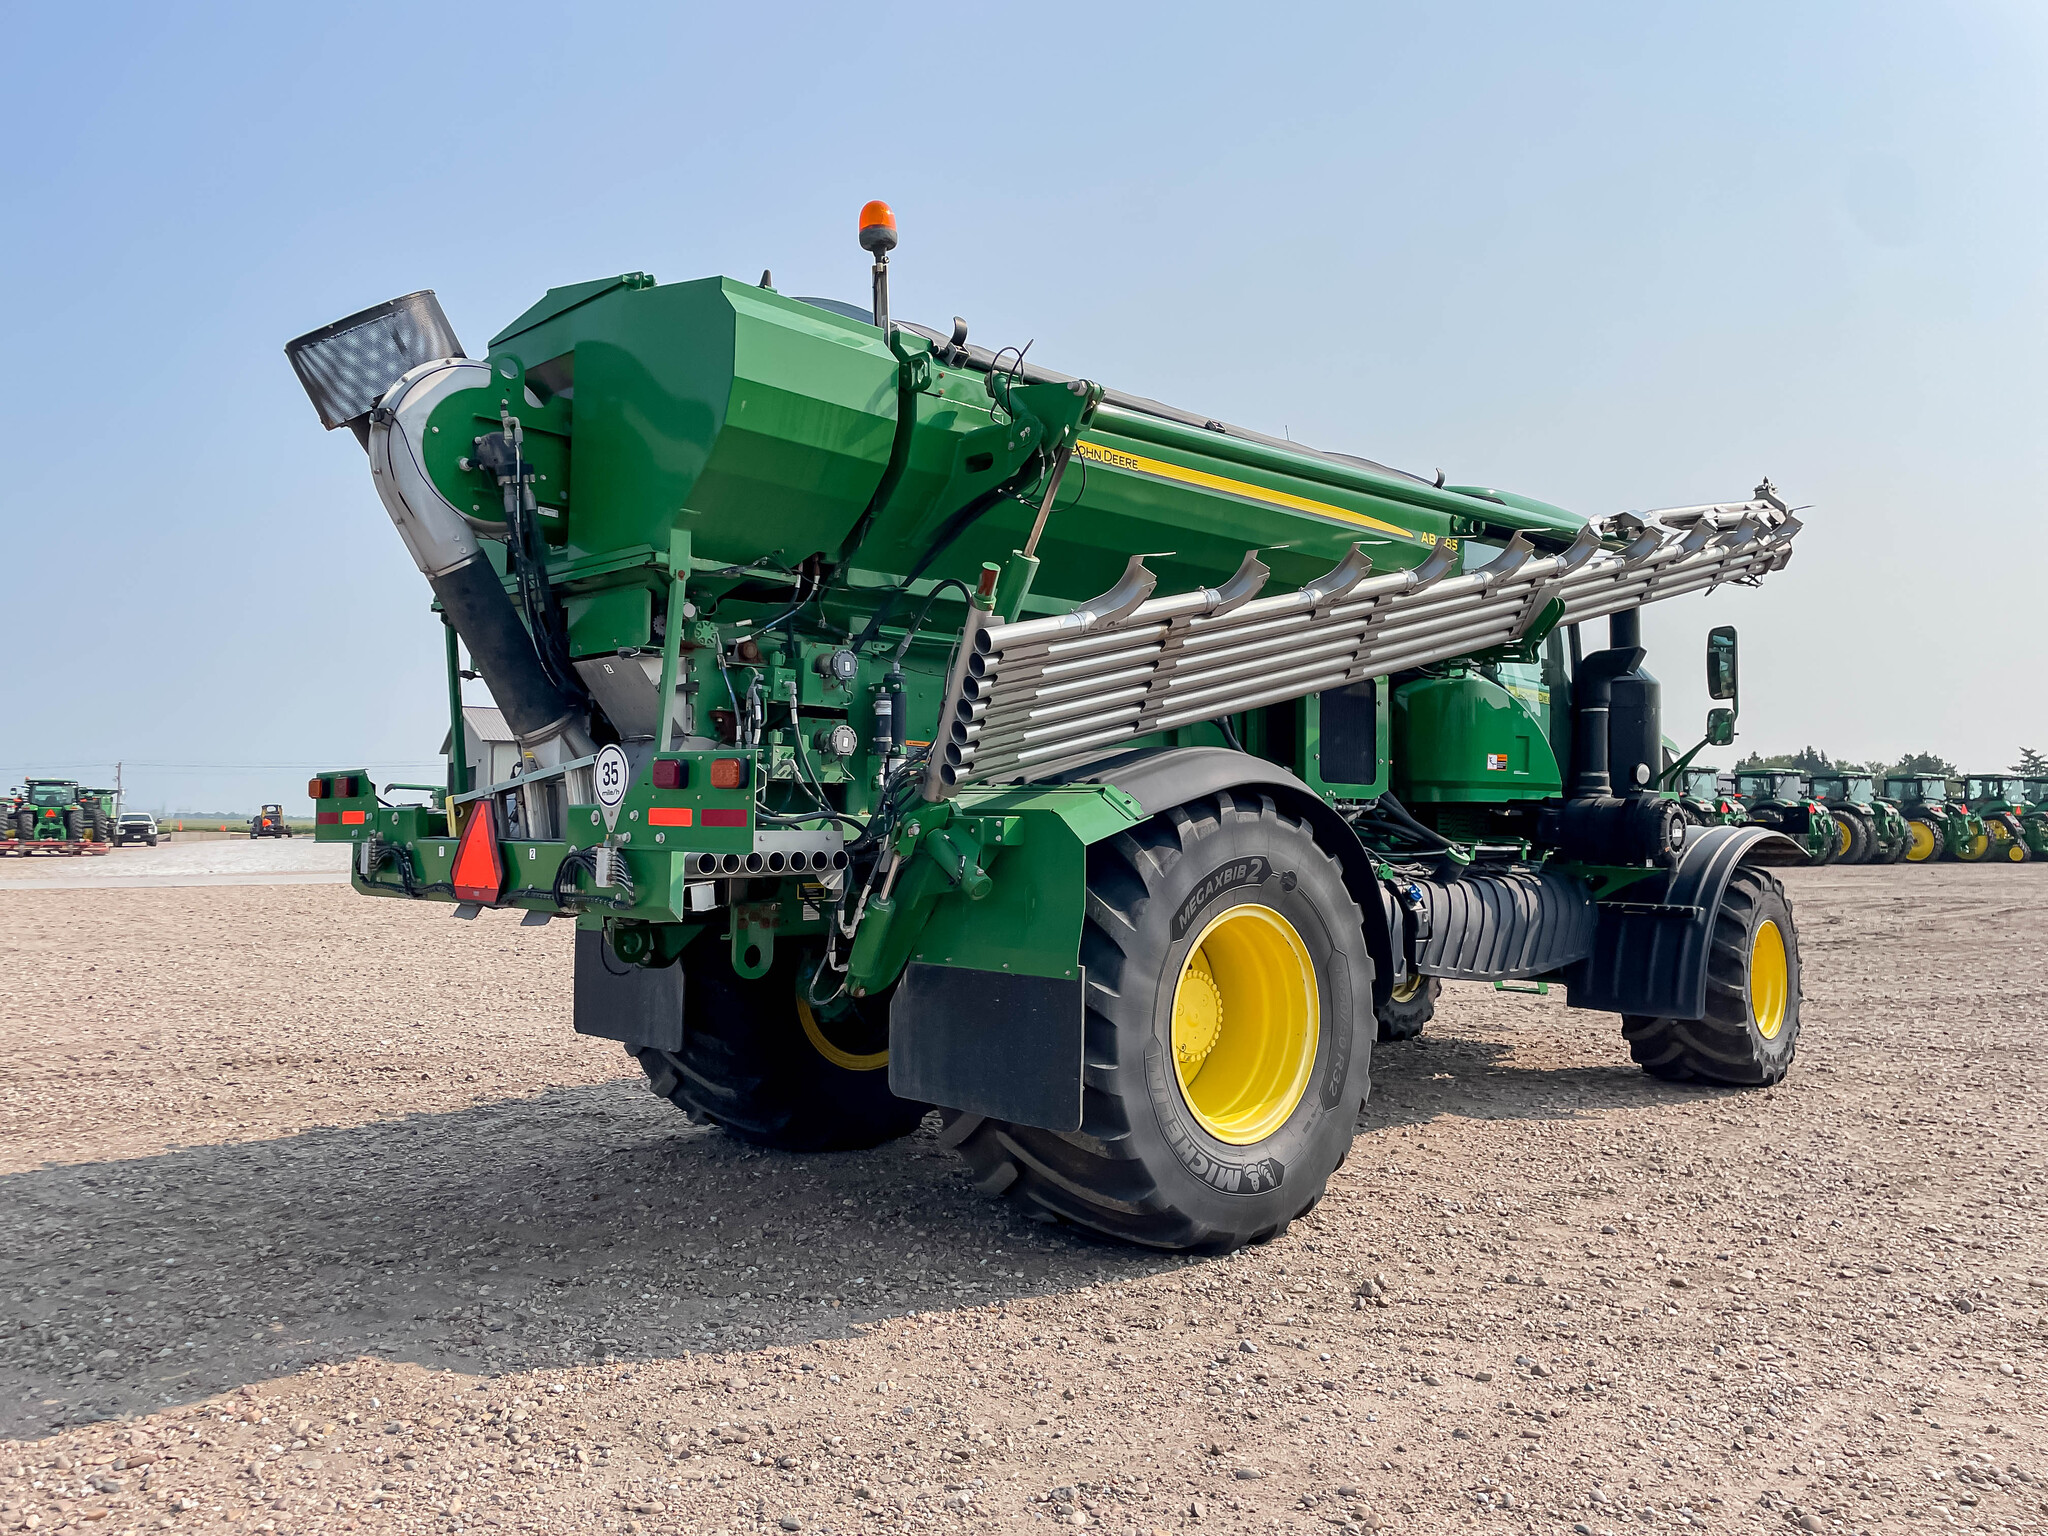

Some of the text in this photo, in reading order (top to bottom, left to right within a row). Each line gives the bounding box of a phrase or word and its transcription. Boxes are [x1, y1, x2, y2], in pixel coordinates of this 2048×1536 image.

[1103, 449, 1139, 470] DEERE
[1421, 531, 1458, 551] AB85
[603, 761, 619, 786] 35
[602, 789, 620, 797] mile/h
[1178, 858, 1263, 930] MEGAXBIB 2
[1328, 1052, 1345, 1097] R32
